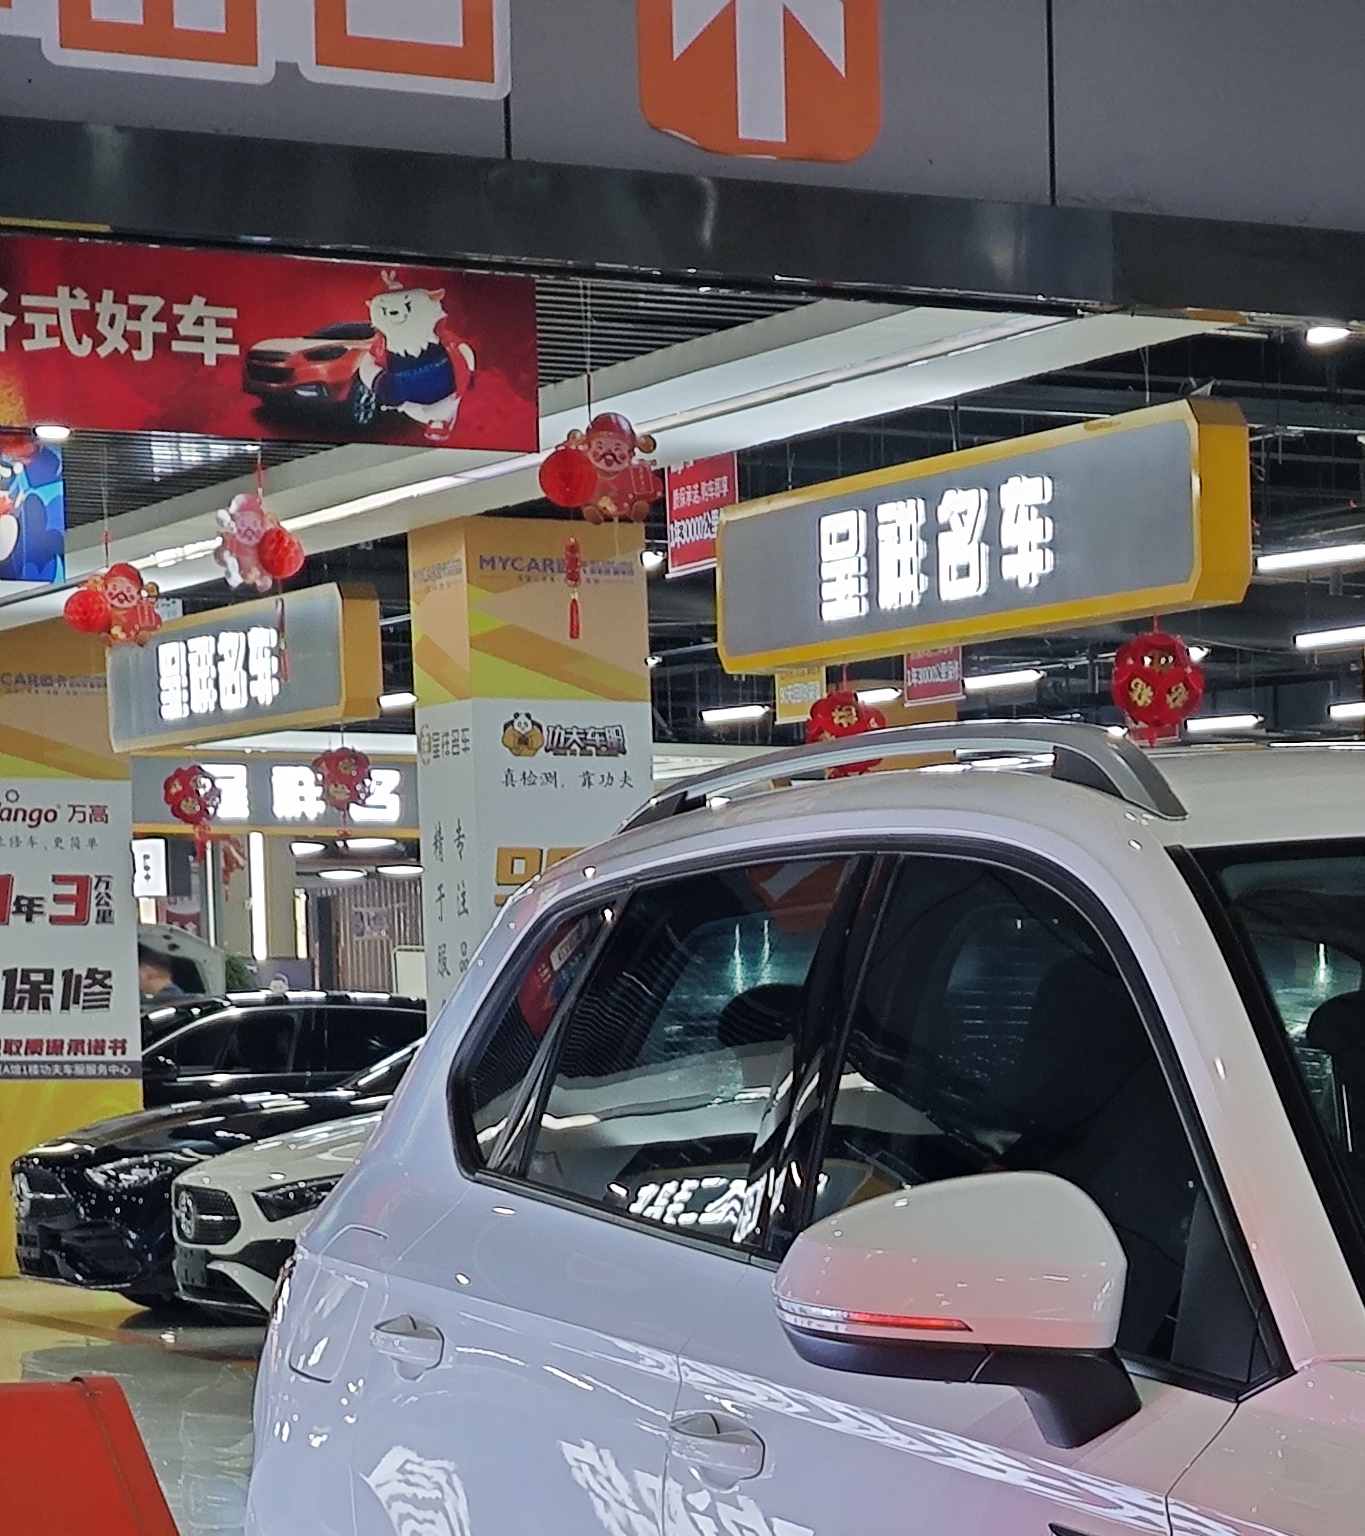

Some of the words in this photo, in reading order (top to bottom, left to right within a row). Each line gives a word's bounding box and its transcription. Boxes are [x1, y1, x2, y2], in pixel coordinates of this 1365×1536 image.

[819, 475, 1054, 622] 呈祥名车
[68, 804, 109, 825] 万高
[2, 967, 113, 1013] 保修
